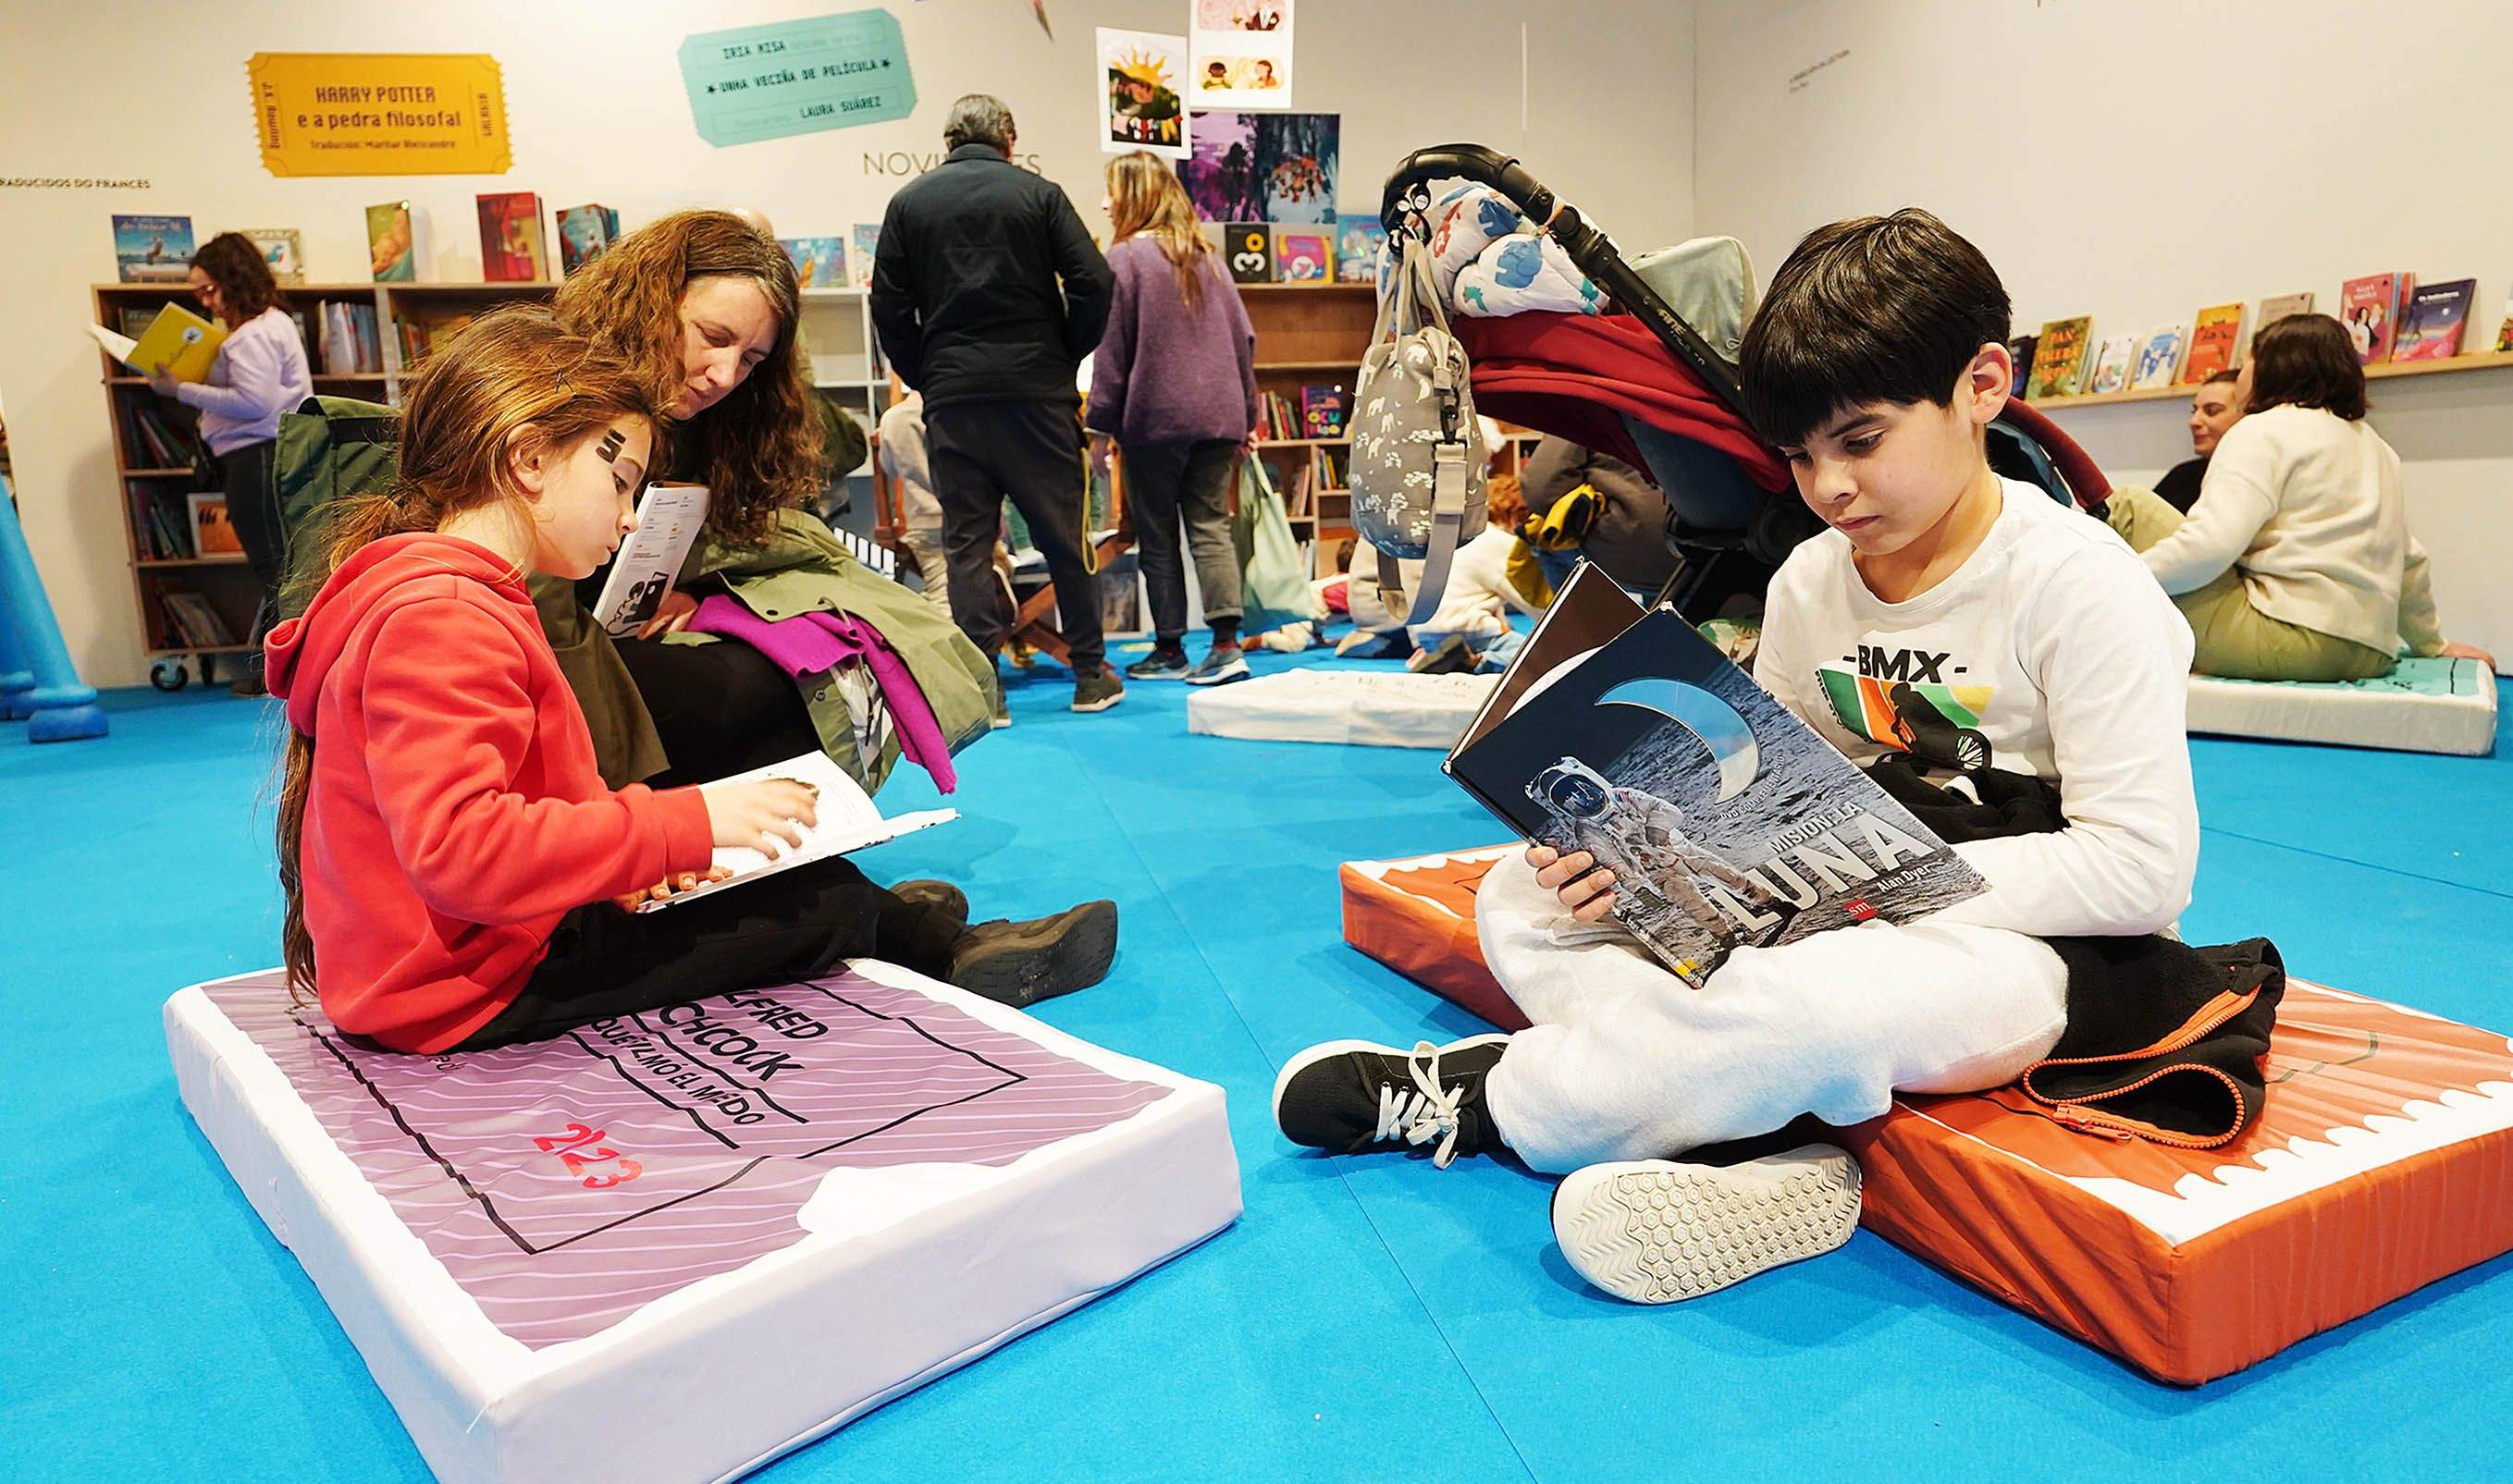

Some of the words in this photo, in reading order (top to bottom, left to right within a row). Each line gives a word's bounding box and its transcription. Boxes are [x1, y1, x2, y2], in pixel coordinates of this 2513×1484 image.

[801, 67, 817, 80] DE
[315, 86, 371, 104] HARRY
[377, 86, 437, 104] POTTER
[298, 112, 308, 128] e
[314, 112, 324, 128] a
[329, 110, 382, 129] pedra
[387, 110, 462, 128] filosofal
[863, 152, 1042, 176] NOVIES
[0, 178, 71, 189] RADUCIDOS
[1720, 809, 1739, 819] DVD
[1740, 753, 1785, 814] COMPLEMENTARIO
[1834, 802, 1866, 822] LA
[1709, 812, 1937, 934] LUNA
[1876, 873, 1906, 894] Alan
[1899, 863, 1932, 882] Dyer
[1849, 901, 1872, 917] sm
[724, 990, 830, 1039] LFRED
[659, 1002, 806, 1082] CHCOCK
[666, 1073, 703, 1090] EL
[687, 1085, 766, 1125] MEDO
